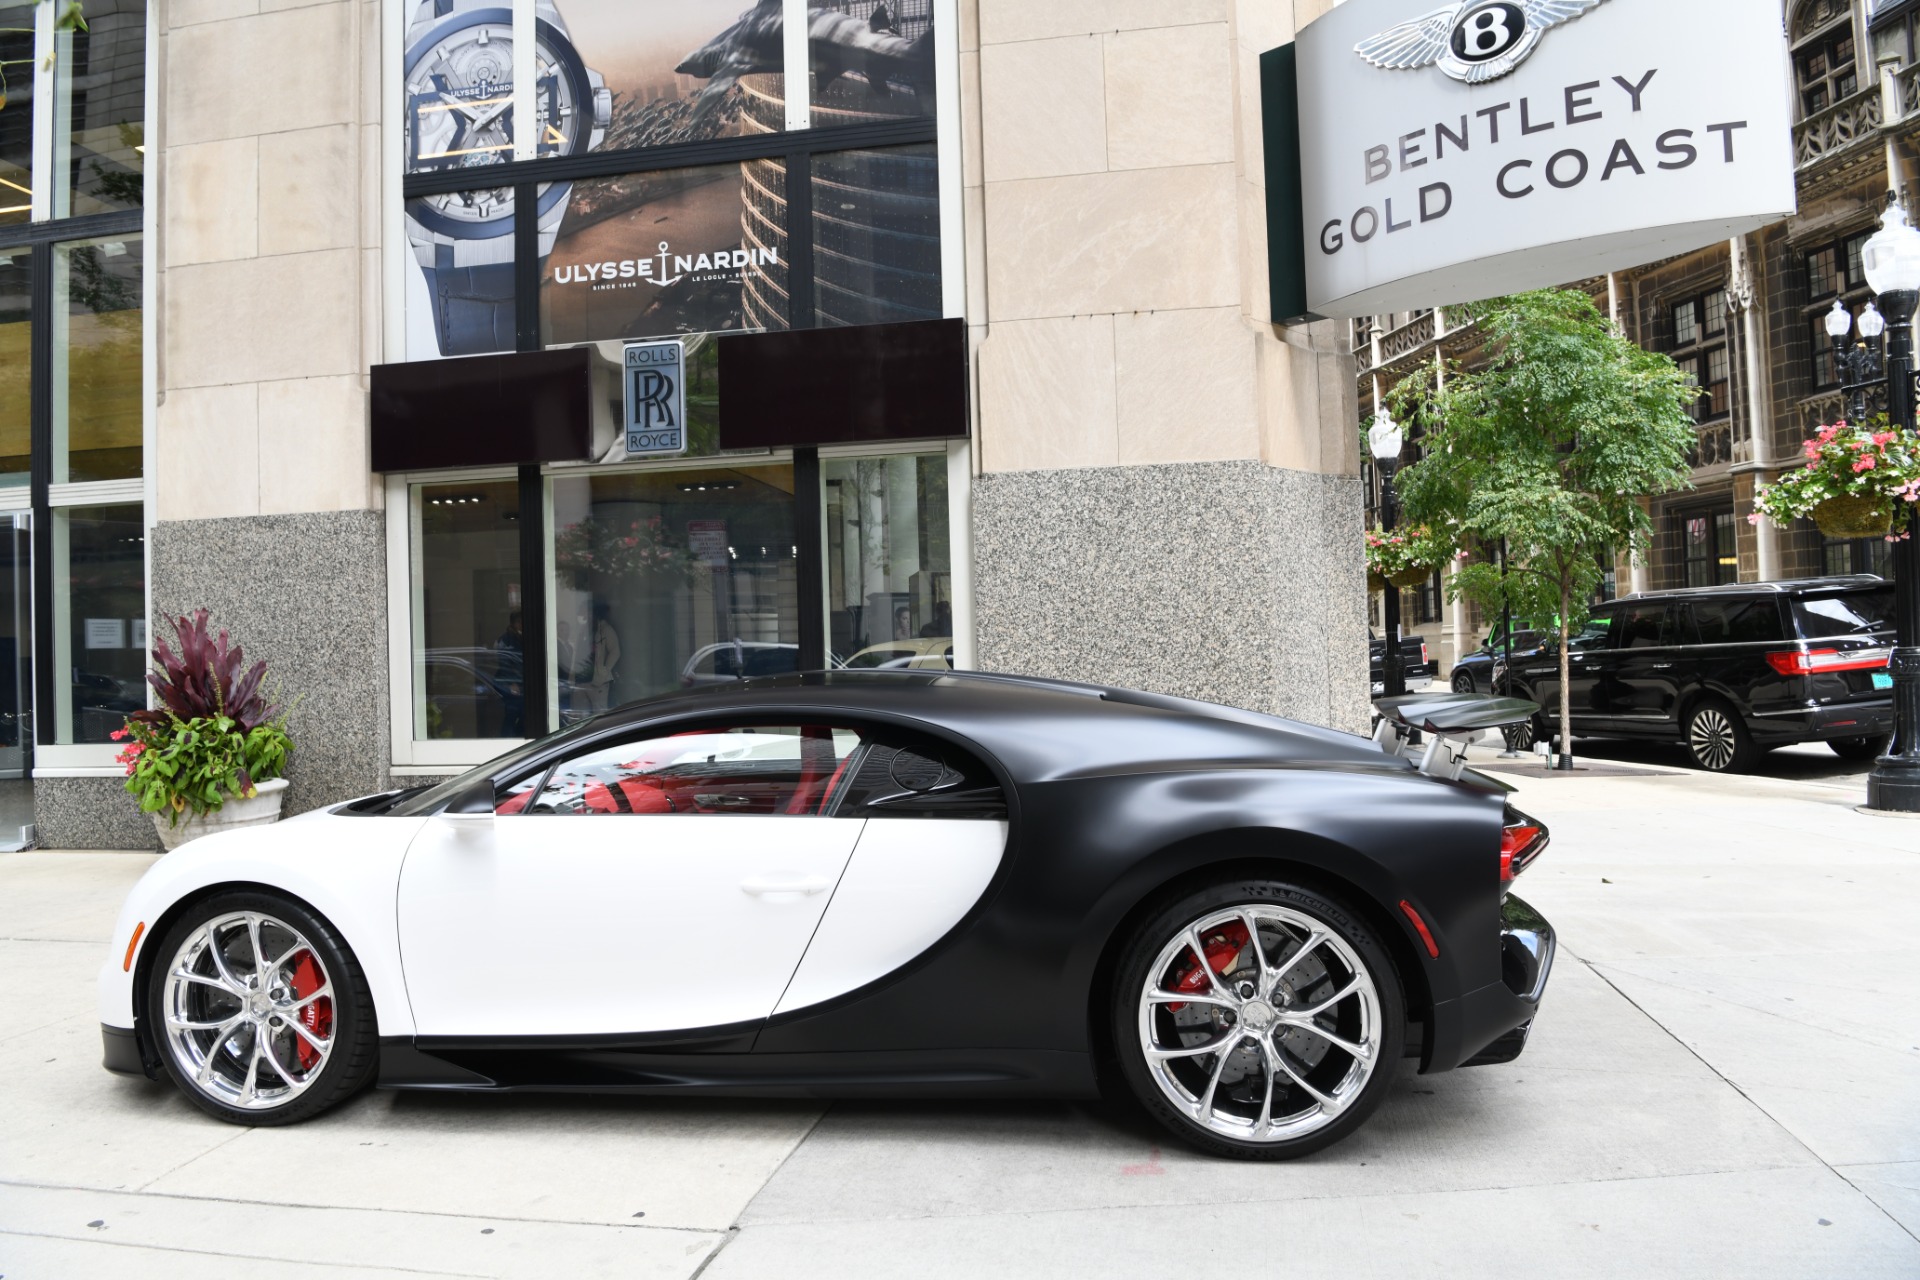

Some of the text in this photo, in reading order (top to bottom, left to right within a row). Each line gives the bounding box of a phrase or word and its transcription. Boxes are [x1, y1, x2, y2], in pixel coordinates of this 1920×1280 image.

[1462, 6, 1510, 56] B
[450, 84, 513, 97] ULYSSE NARDI
[1363, 68, 1658, 185] BENTLEY
[1320, 120, 1748, 256] GOLD COAST
[554, 246, 777, 284] ULYSSE NARDIN
[629, 348, 676, 364] ROLLS
[633, 369, 675, 428] RR
[630, 432, 678, 449] ROYCE
[1289, 891, 1349, 926] MICHELIN
[1189, 968, 1206, 984] BUGA
[306, 1004, 316, 1028] GATTI
